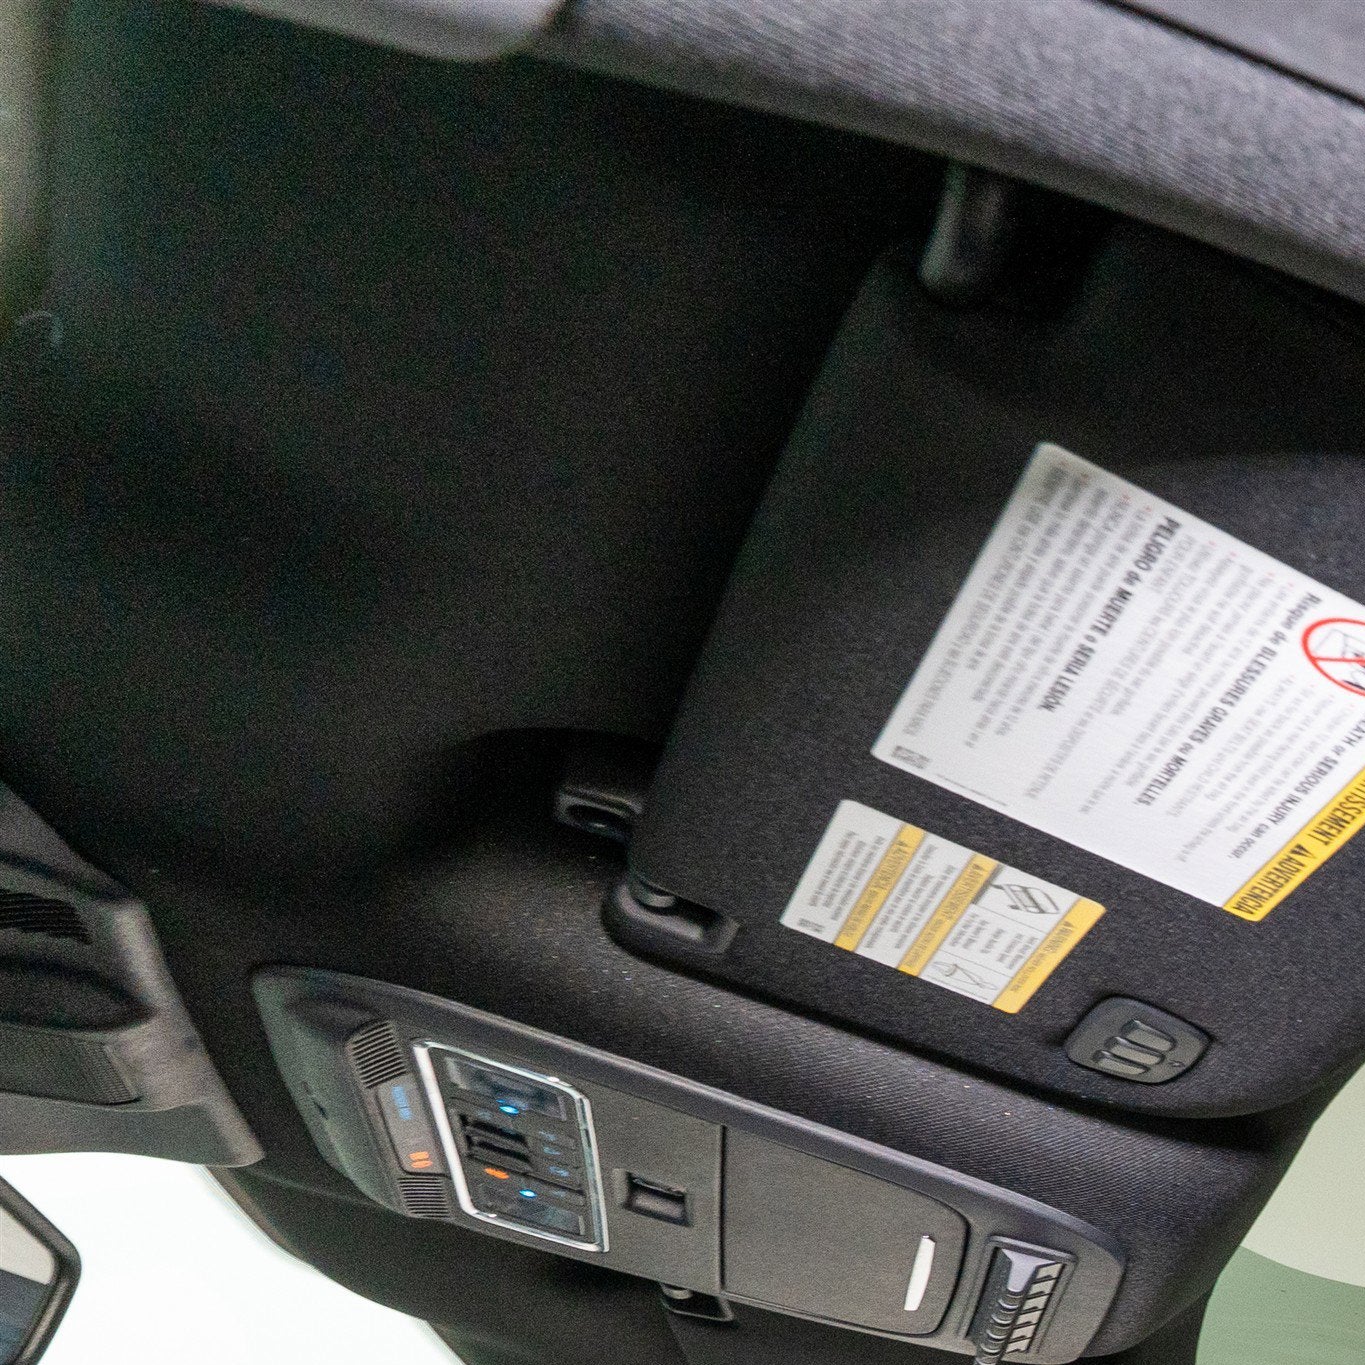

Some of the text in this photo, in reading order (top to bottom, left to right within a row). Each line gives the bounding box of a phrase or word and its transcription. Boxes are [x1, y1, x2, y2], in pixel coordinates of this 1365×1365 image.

[1130, 514, 1184, 575] PELIGRO
[1120, 568, 1147, 590] de
[1088, 585, 1136, 638] MUERTE
[1277, 589, 1324, 633] Risque
[1266, 629, 1293, 650] de
[1060, 641, 1097, 678] SERIA
[1217, 644, 1280, 709] BLESSURES
[1185, 703, 1230, 745] GRAVES
[1175, 740, 1196, 756] ou
[1329, 743, 1346, 756] or
[1292, 754, 1339, 796] SERIOUS
[1263, 792, 1302, 825] INJURY
[1248, 822, 1271, 839] can
[1230, 853, 1308, 917] ADVERTENCIA
